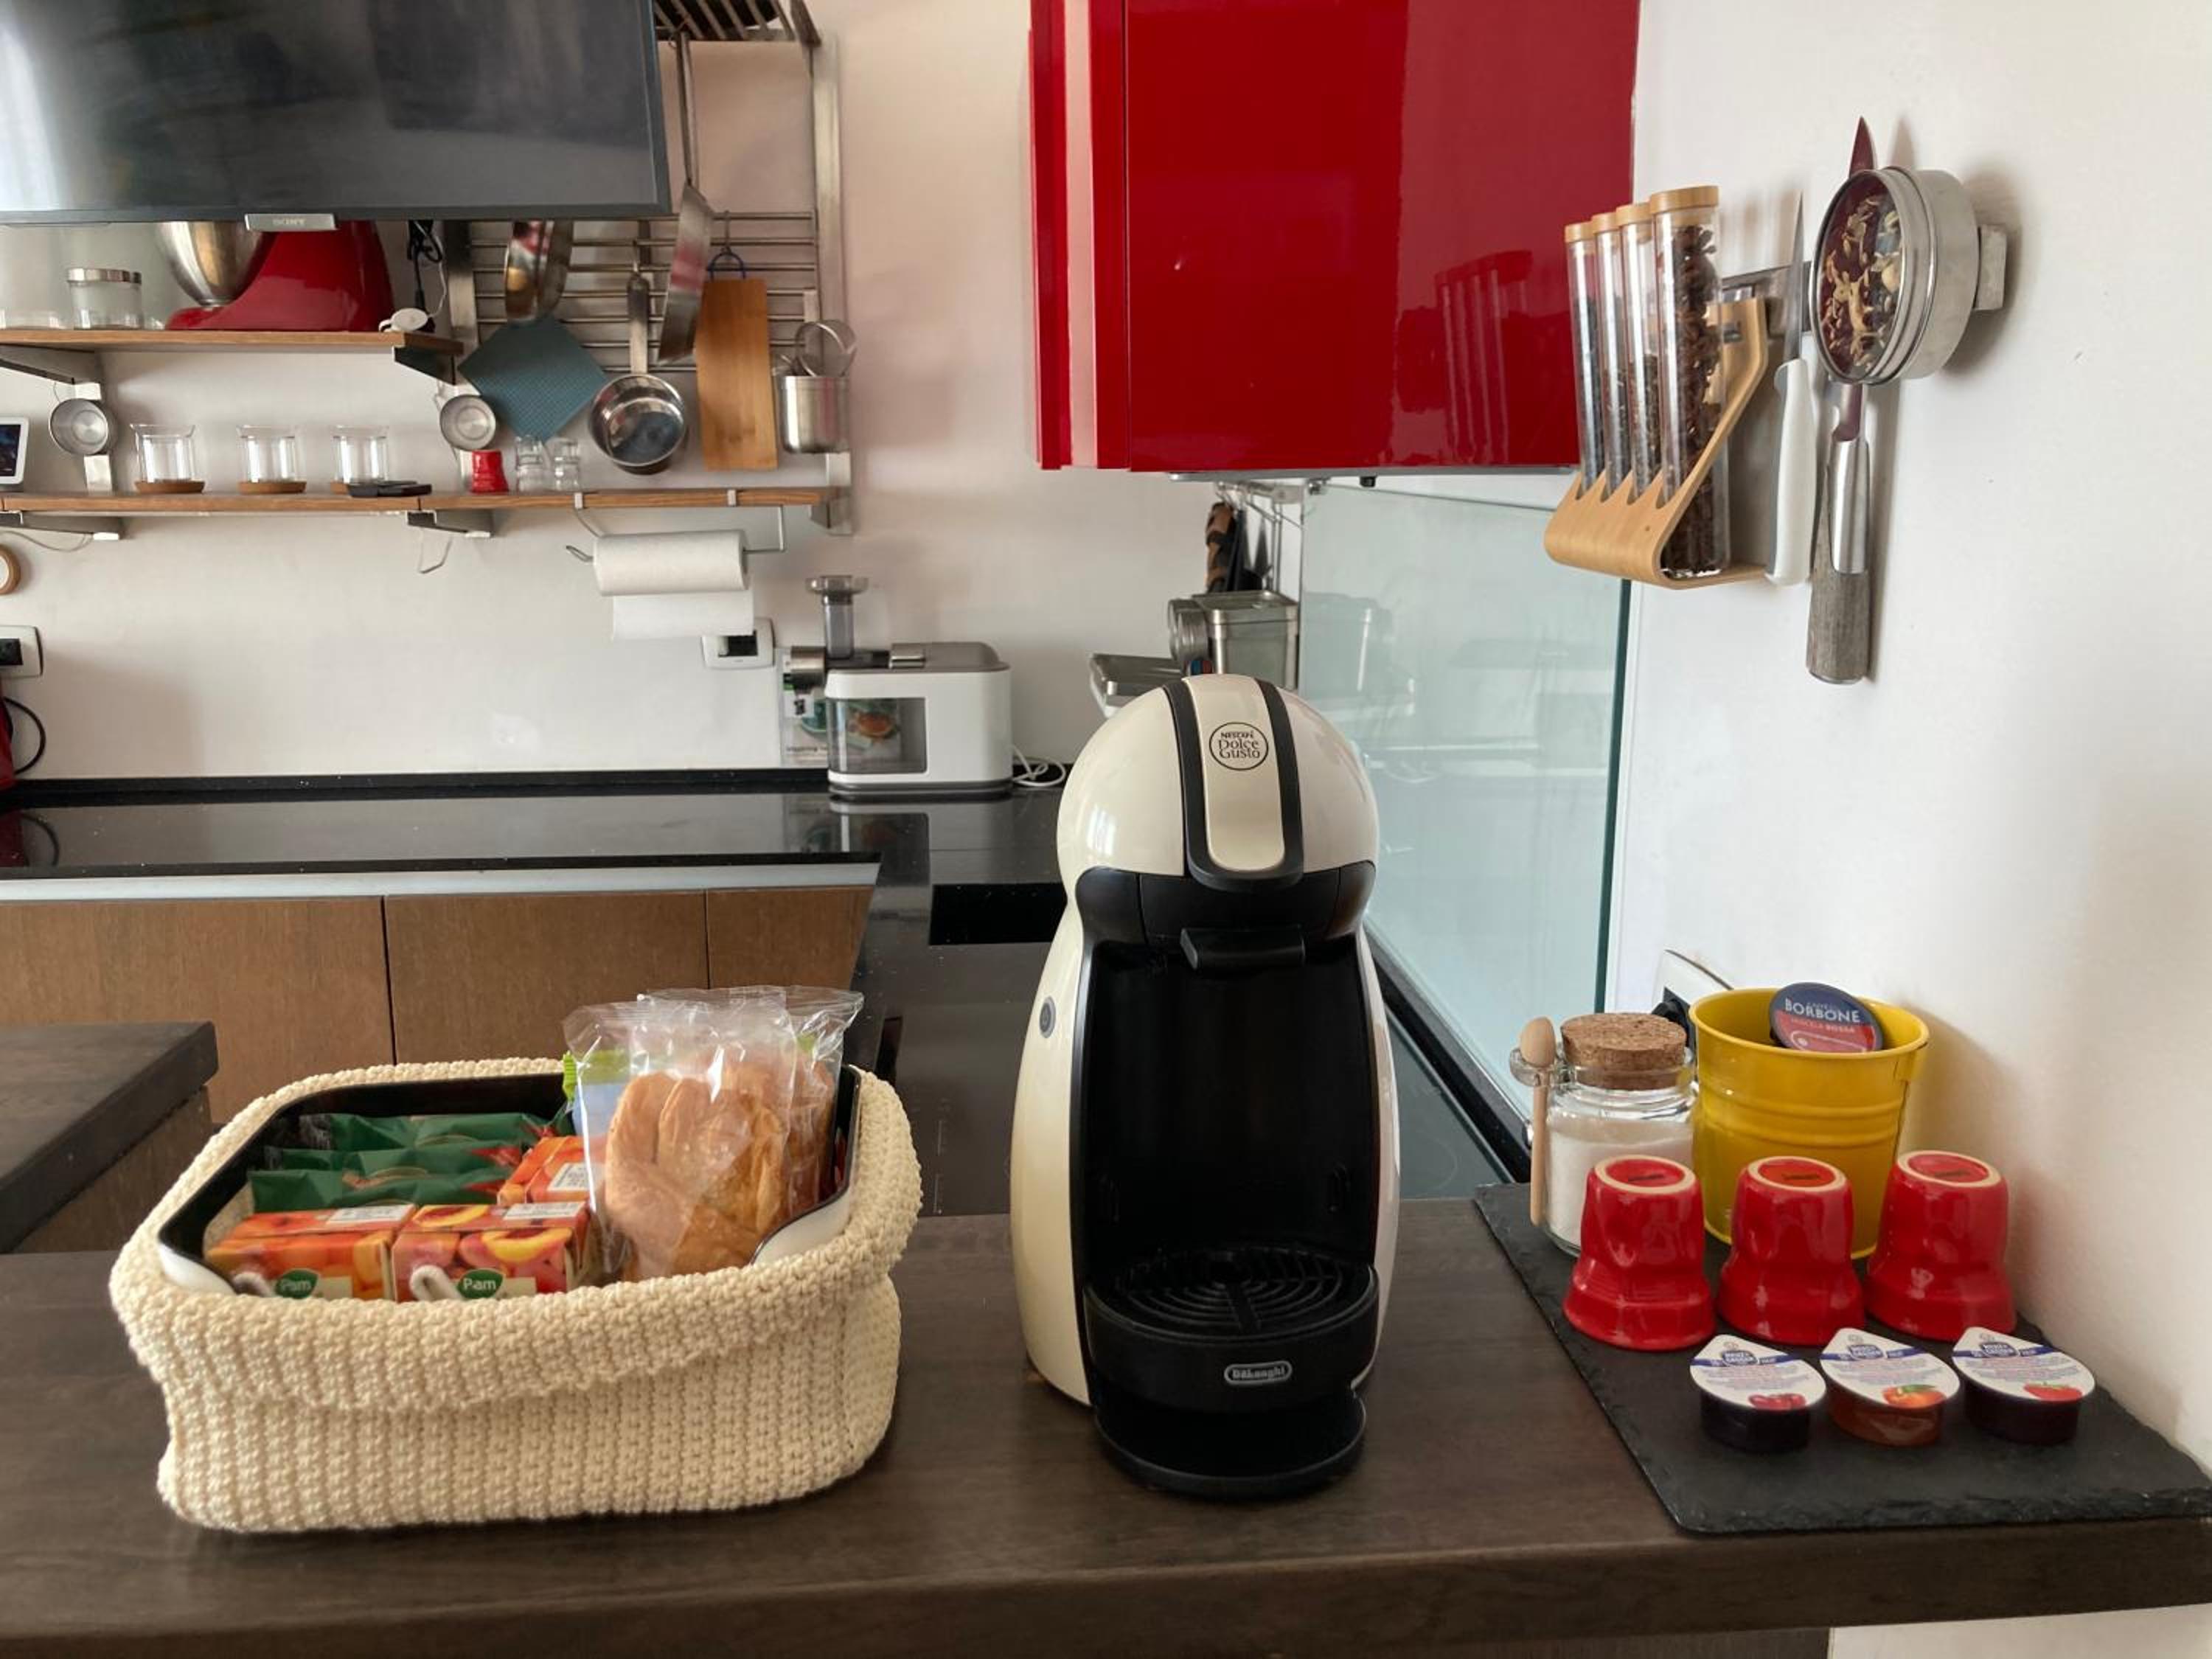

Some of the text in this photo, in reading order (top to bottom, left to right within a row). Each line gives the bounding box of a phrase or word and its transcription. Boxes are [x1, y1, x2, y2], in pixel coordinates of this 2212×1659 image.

[1218, 738, 1259, 750] Dolce
[1785, 998, 1860, 1023] BORBONE
[282, 1279, 313, 1292] Pam
[464, 1278, 496, 1290] Pam
